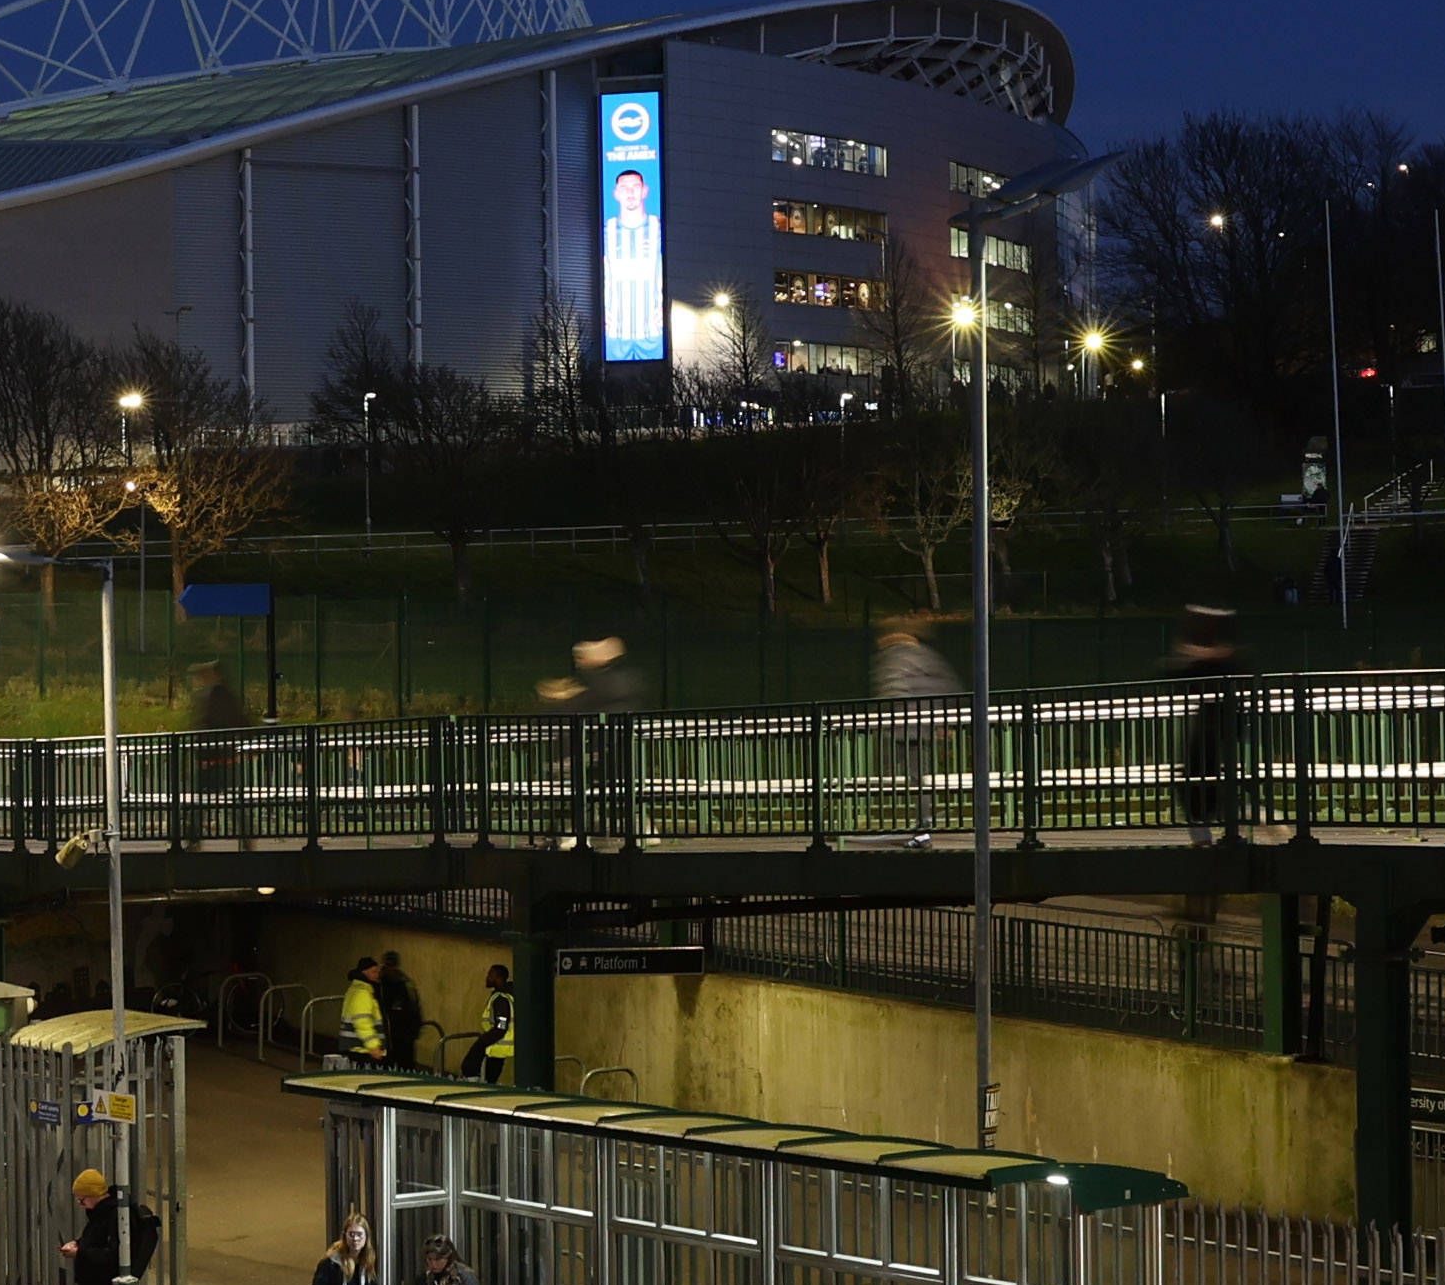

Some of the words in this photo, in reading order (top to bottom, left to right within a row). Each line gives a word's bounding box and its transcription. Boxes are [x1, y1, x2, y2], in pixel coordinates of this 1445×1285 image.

[606, 151, 627, 161] THE
[627, 150, 656, 160] AMEX
[593, 955, 638, 970] Platform
[641, 956, 648, 969] 1
[1410, 1095, 1436, 1113] ersity
